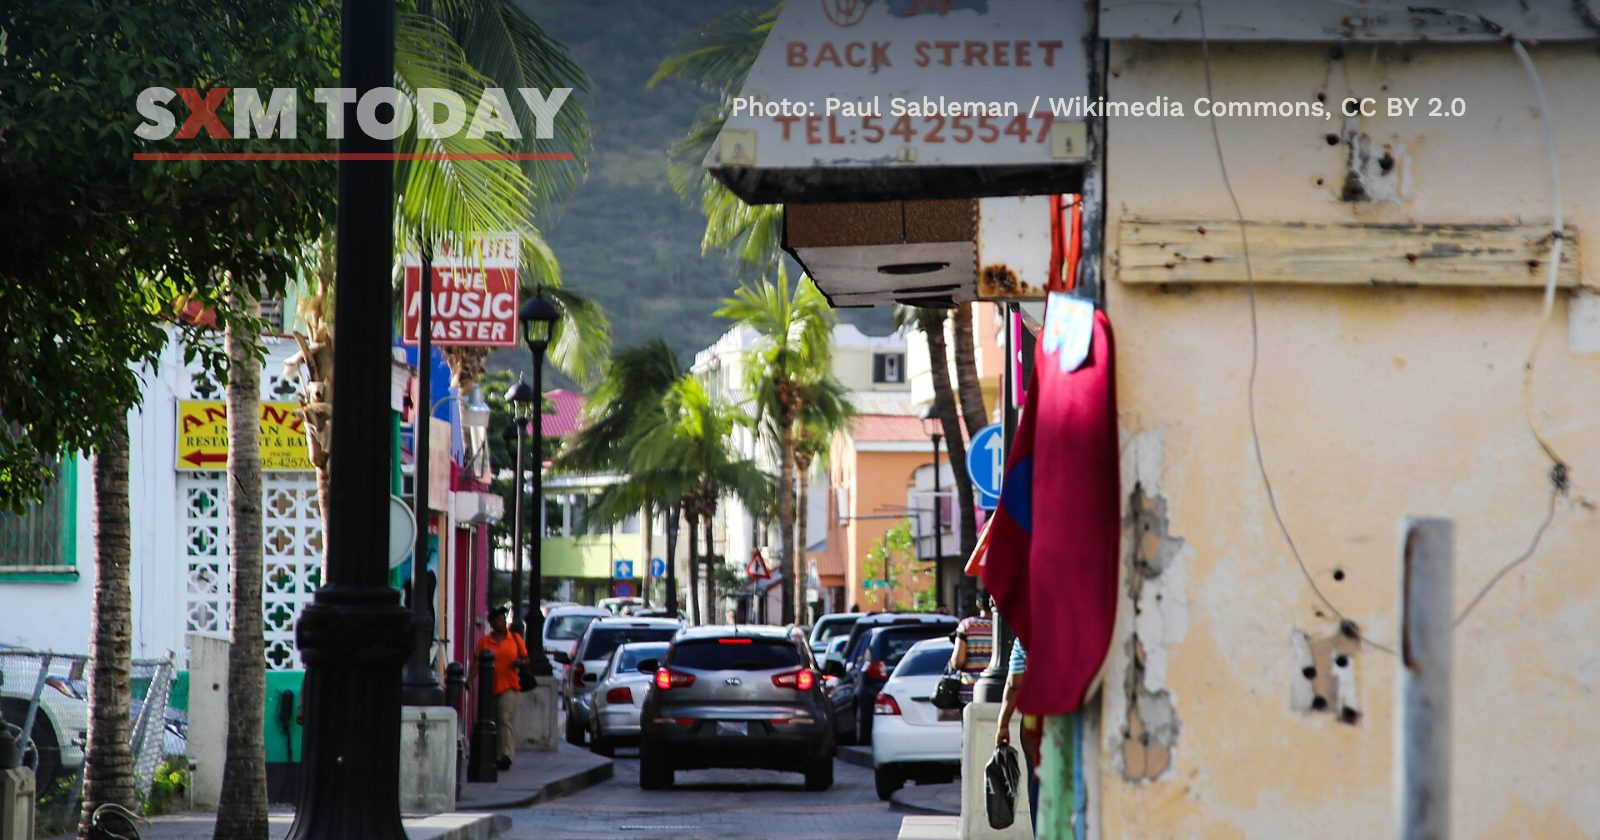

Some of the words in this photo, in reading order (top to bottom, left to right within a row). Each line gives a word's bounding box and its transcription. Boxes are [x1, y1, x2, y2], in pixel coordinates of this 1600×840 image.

[785, 40, 893, 69] BACK
[914, 40, 1064, 68] STREET
[438, 272, 487, 290] THE
[274, 436, 283, 448] &
